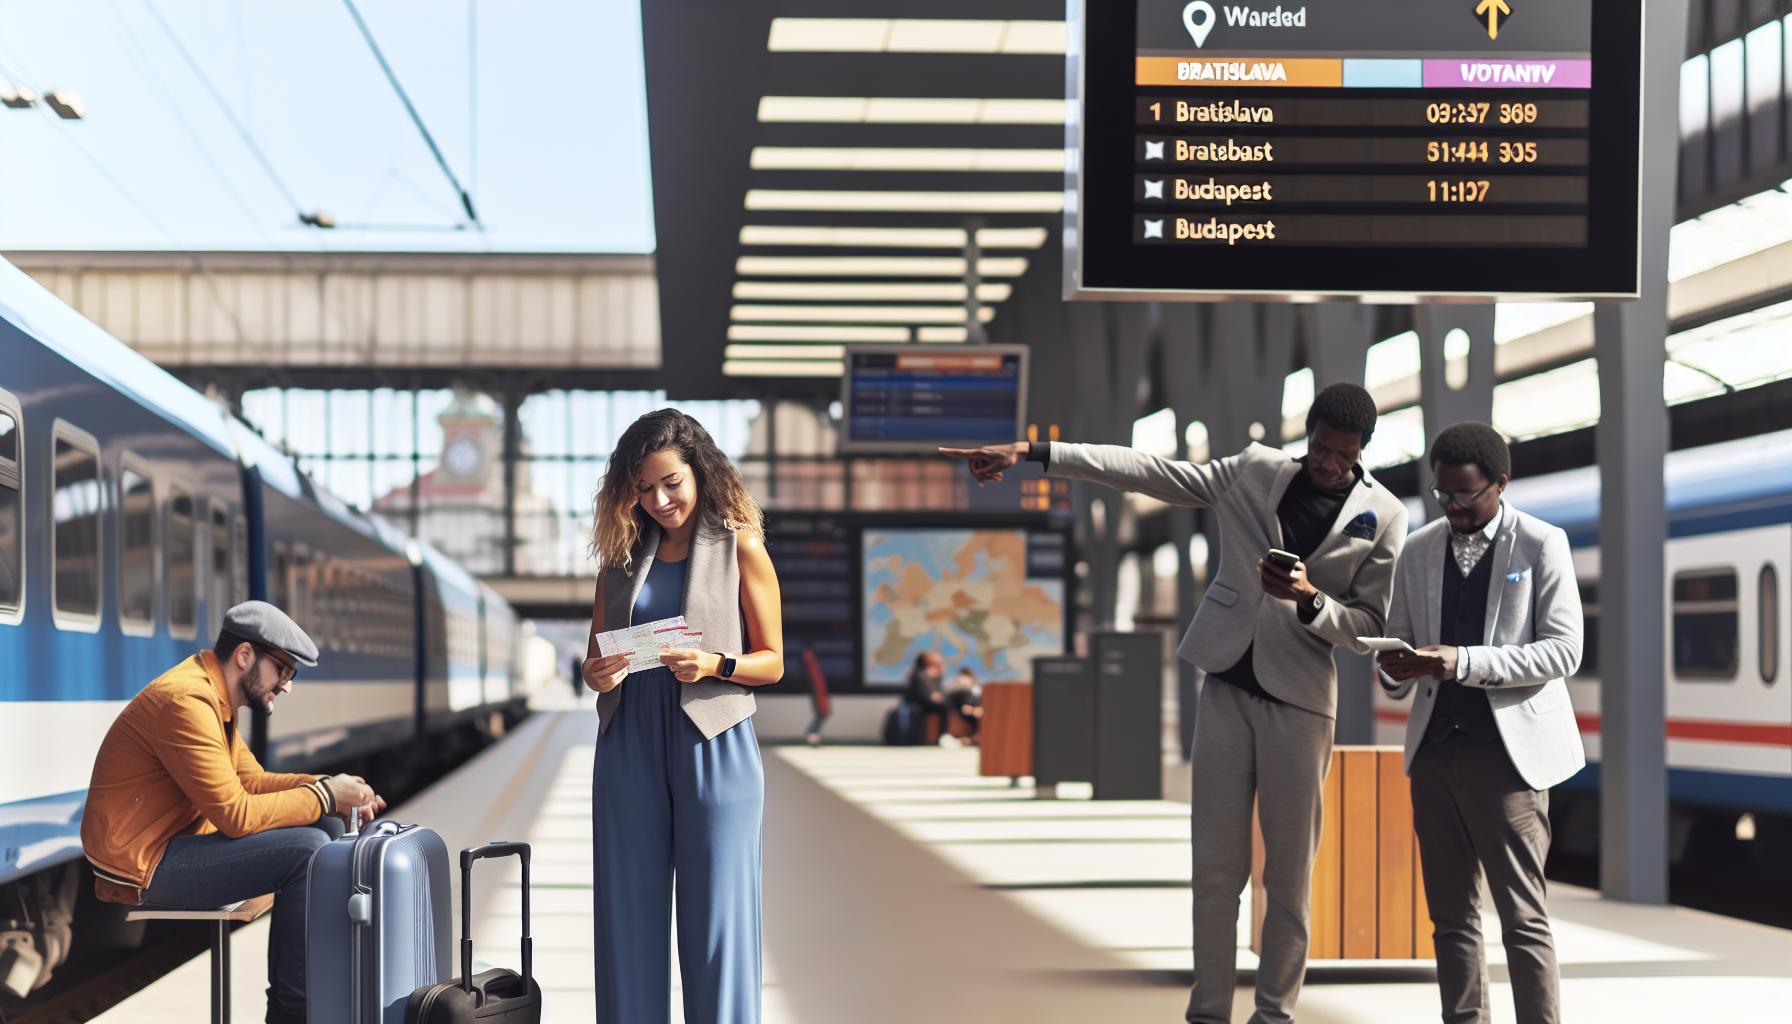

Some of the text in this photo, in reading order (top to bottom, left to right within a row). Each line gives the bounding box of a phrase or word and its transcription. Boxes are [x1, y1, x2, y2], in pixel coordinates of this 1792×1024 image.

[1177, 62, 1288, 82] BRATISLAVA
[1149, 102, 1161, 121] 1
[1176, 100, 1274, 123] Bratislava
[1175, 177, 1273, 206] Budapest
